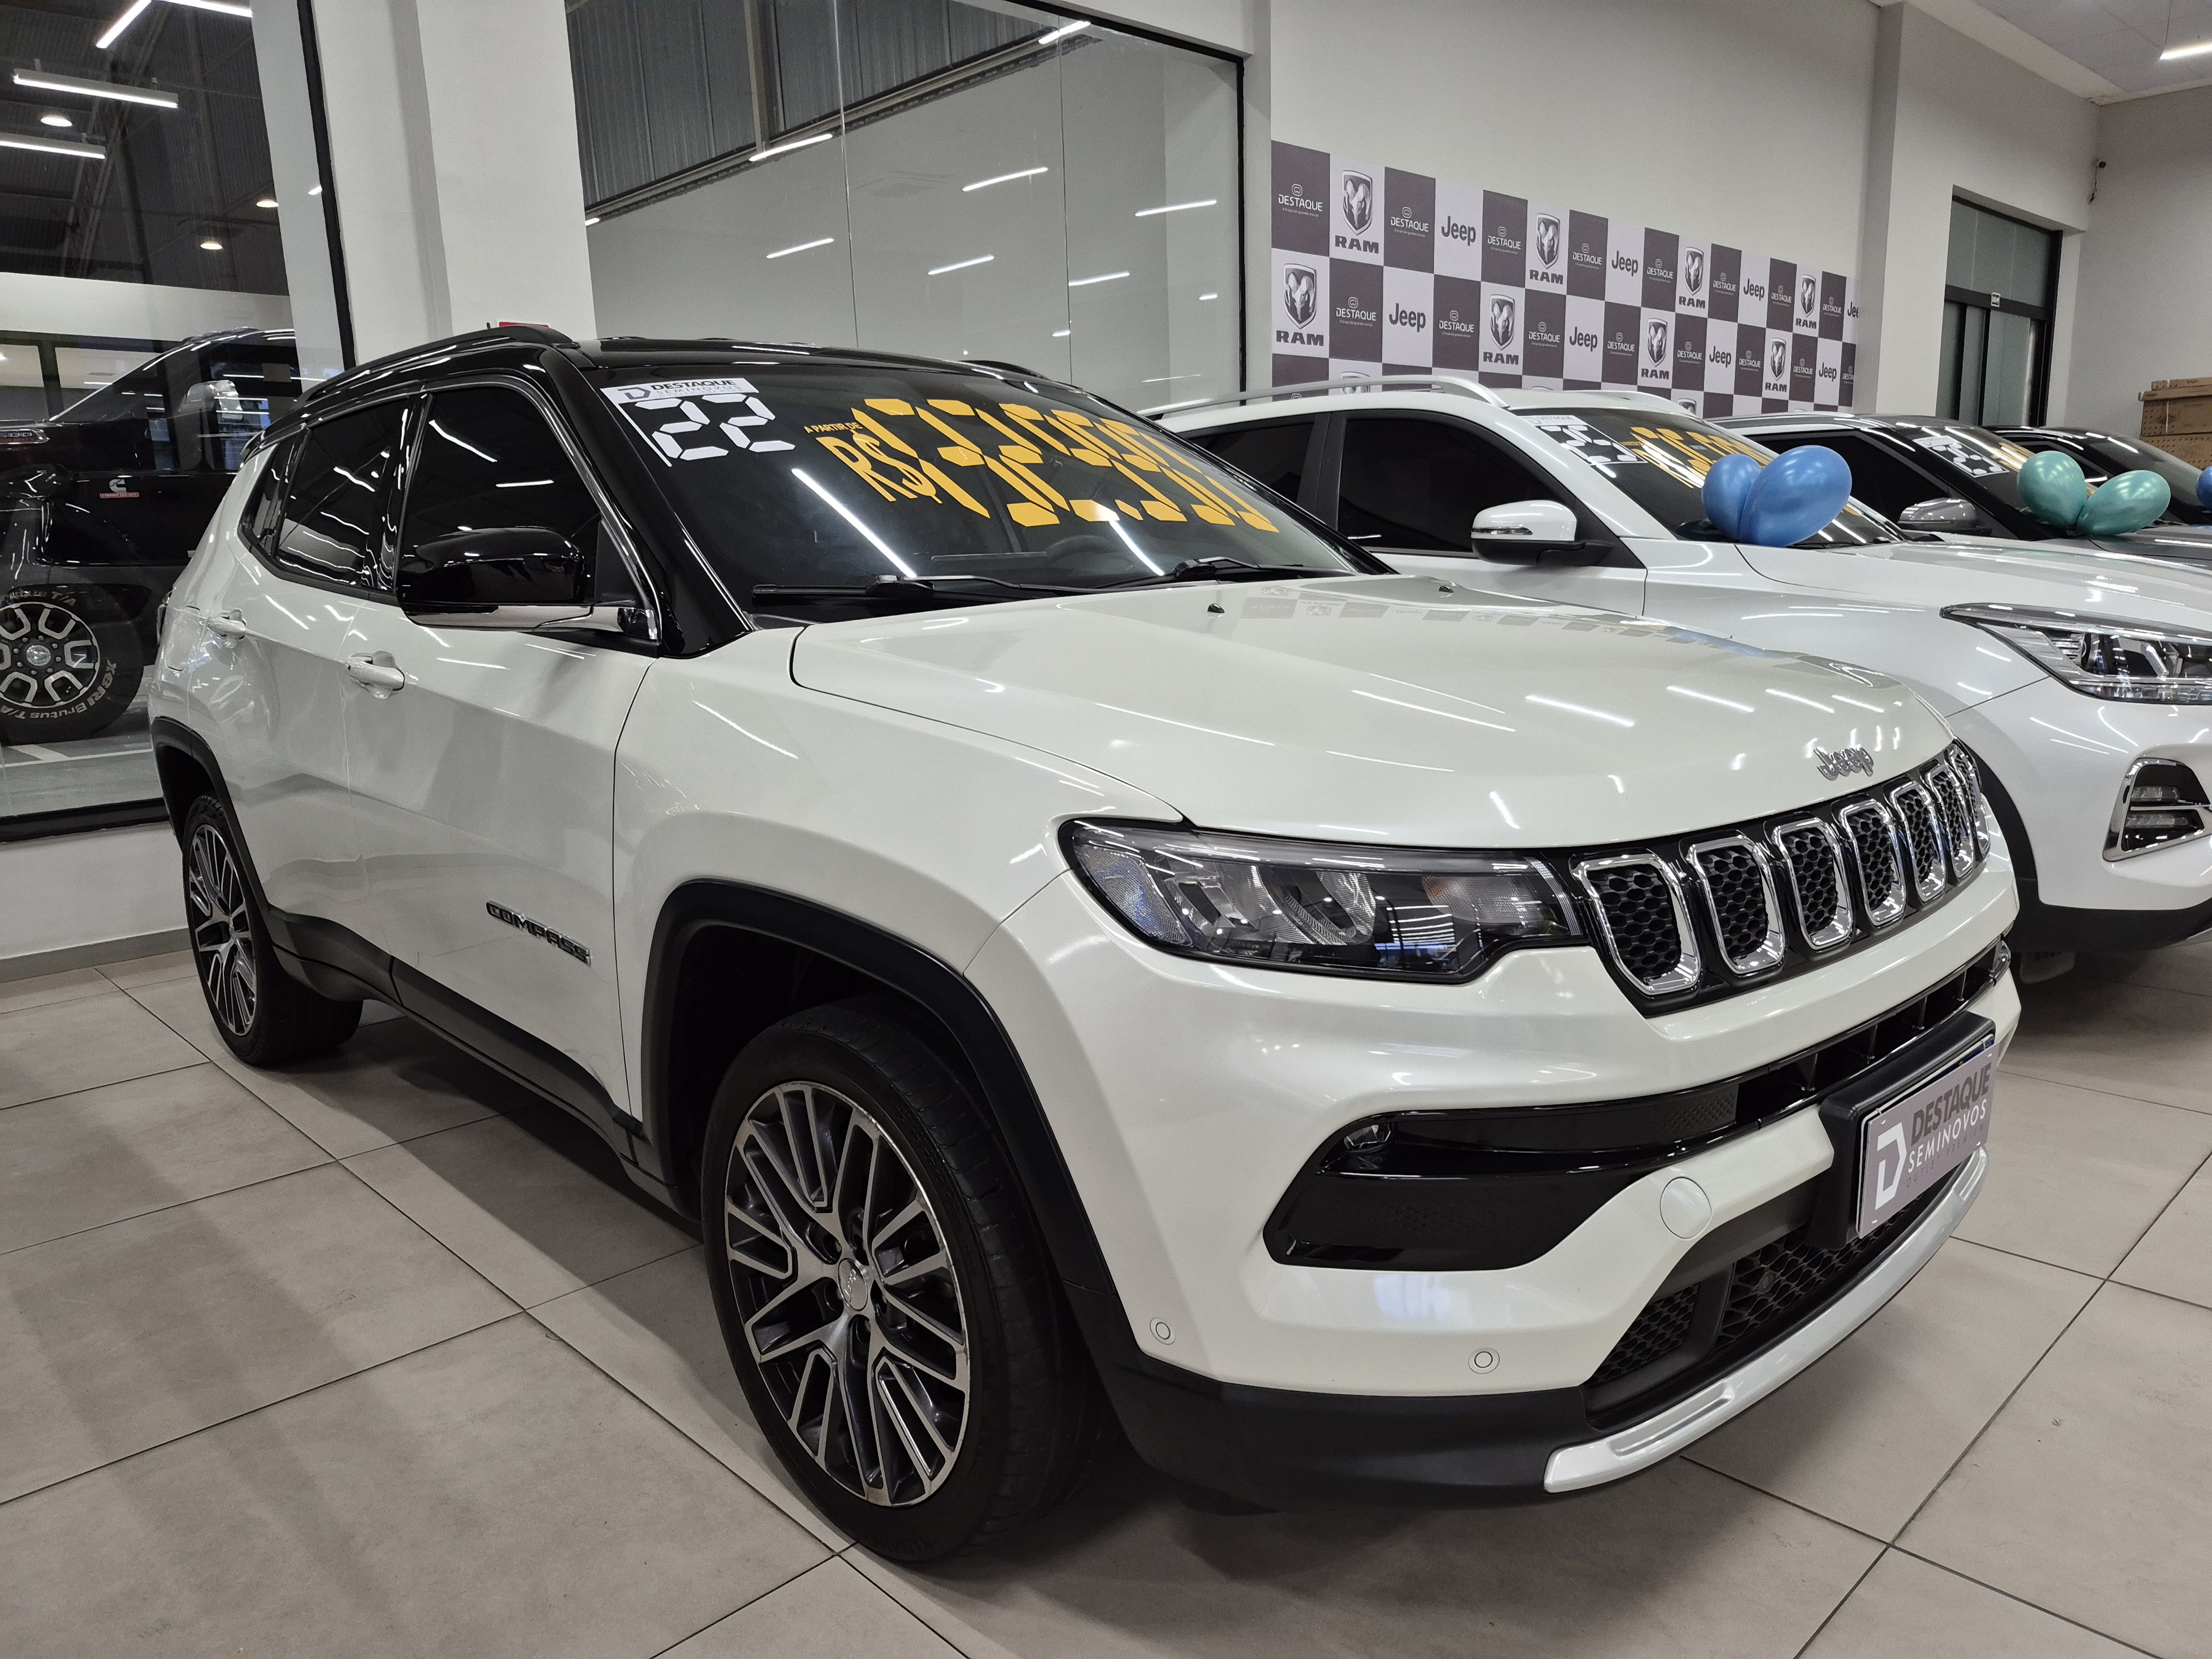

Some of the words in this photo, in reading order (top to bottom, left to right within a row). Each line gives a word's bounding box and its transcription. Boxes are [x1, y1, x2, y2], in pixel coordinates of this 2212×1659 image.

[1278, 194, 1323, 212] DESTAQUE
[1391, 216, 1429, 232] DESTAQUE
[1441, 215, 1476, 246] Jeep
[1335, 235, 1379, 254] RAM
[1488, 236, 1521, 249] DESTAQUE
[1572, 252, 1603, 265] DESTAQUE
[1611, 250, 1638, 276] Jeep
[1530, 269, 1564, 285] RAM
[1647, 267, 1674, 279] DESTAQUE
[1713, 280, 1736, 292] DESTAQUE
[1743, 278, 1765, 301] Jeep
[1679, 296, 1706, 309] RAM
[1336, 307, 1376, 321] DESTAQUE
[1389, 303, 1426, 332] Jeep
[1439, 321, 1474, 332] DESTAQUE
[1796, 318, 1817, 329] RAM
[1276, 330, 1324, 346] RAM
[1528, 331, 1560, 343] DESTAQUE
[1569, 326, 1598, 352] Jeep
[1608, 341, 1635, 352] DESTAQUE
[1483, 352, 1519, 365] RAM
[1677, 350, 1703, 360] DESTAQUE
[1709, 346, 1731, 368] Jeep
[1739, 358, 1761, 368] DESTAQUE
[1641, 368, 1670, 379] RAM
[1819, 362, 1837, 382] Jeep
[650, 380, 737, 390] DESTAQUE
[656, 385, 741, 395] SEMINOVOS
[1765, 382, 1787, 392] RAM
[635, 394, 795, 461] 22
[811, 423, 849, 432] PARTIR
[30, 701, 87, 719] Brutus
[1813, 745, 1874, 781] Jeep
[486, 901, 592, 968] COMPASS
[1911, 1062, 1992, 1146] DESTAQUE
[1908, 1099, 1987, 1173] SEMINOVOS
